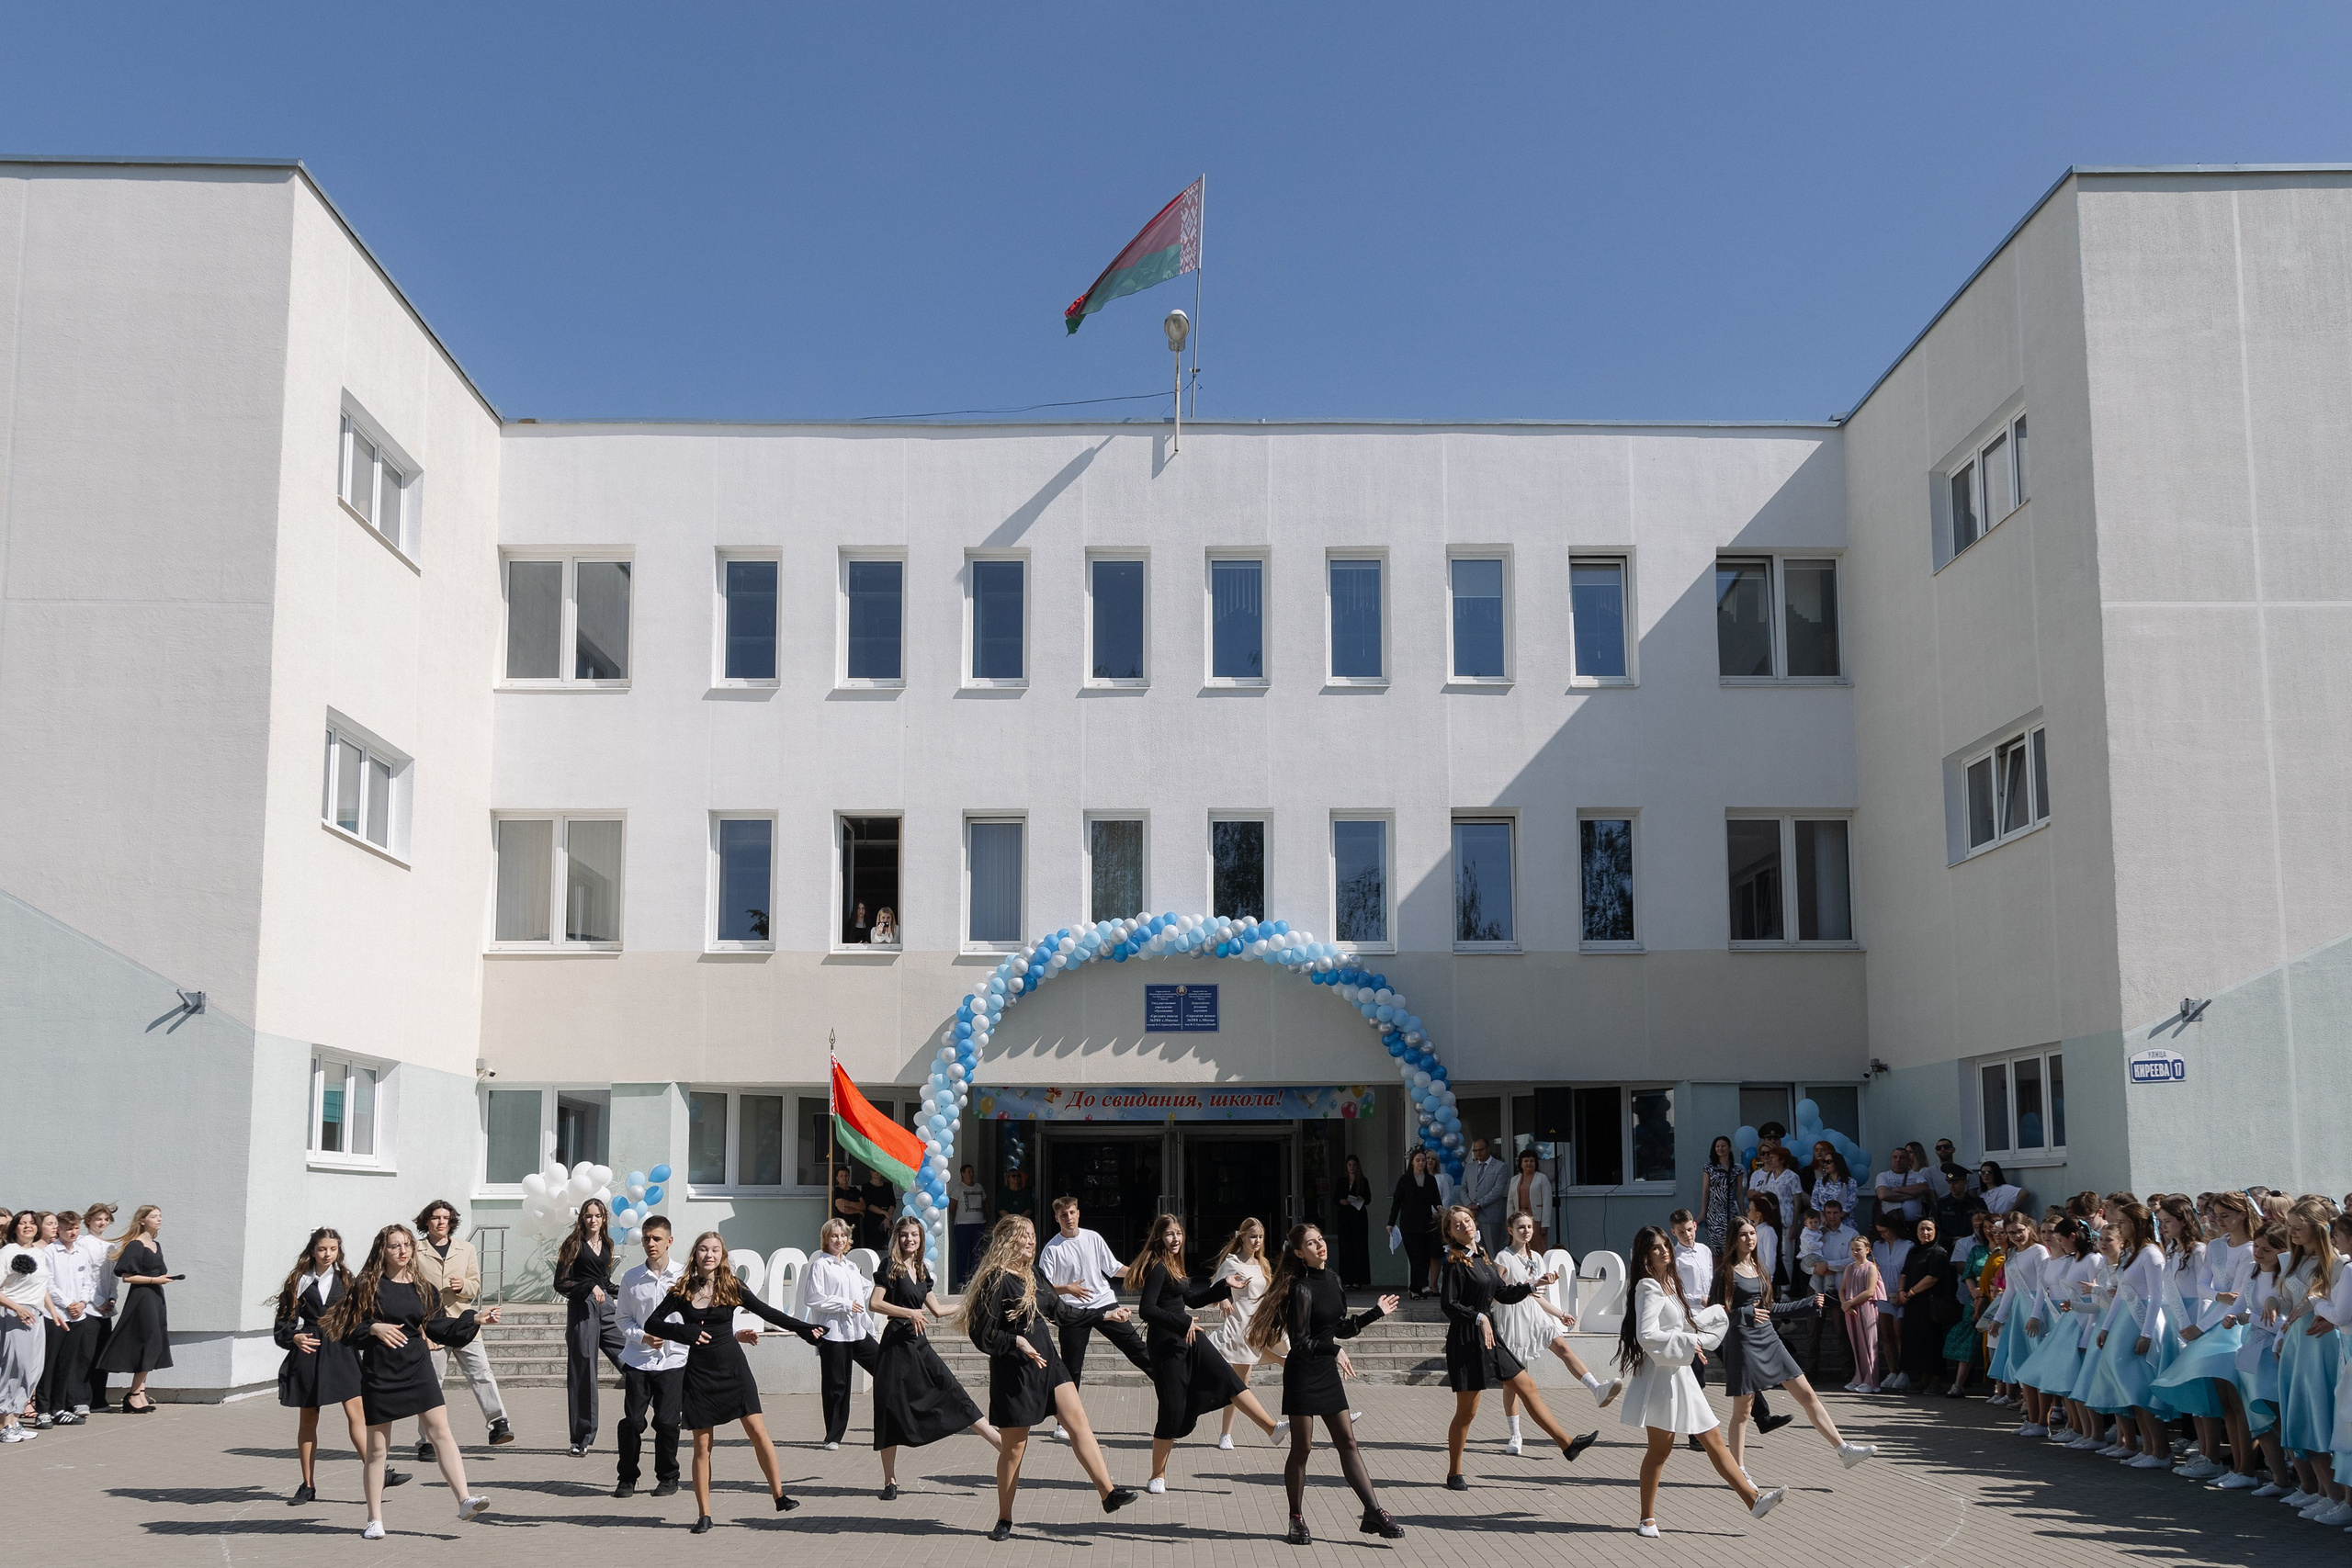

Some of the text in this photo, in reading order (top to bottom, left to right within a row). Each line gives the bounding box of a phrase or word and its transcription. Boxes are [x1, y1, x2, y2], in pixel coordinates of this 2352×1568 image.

[2133, 1063, 2182, 1077] КИРЕЕВА 17
[1065, 1090, 1284, 1110] До свидания, школа!
